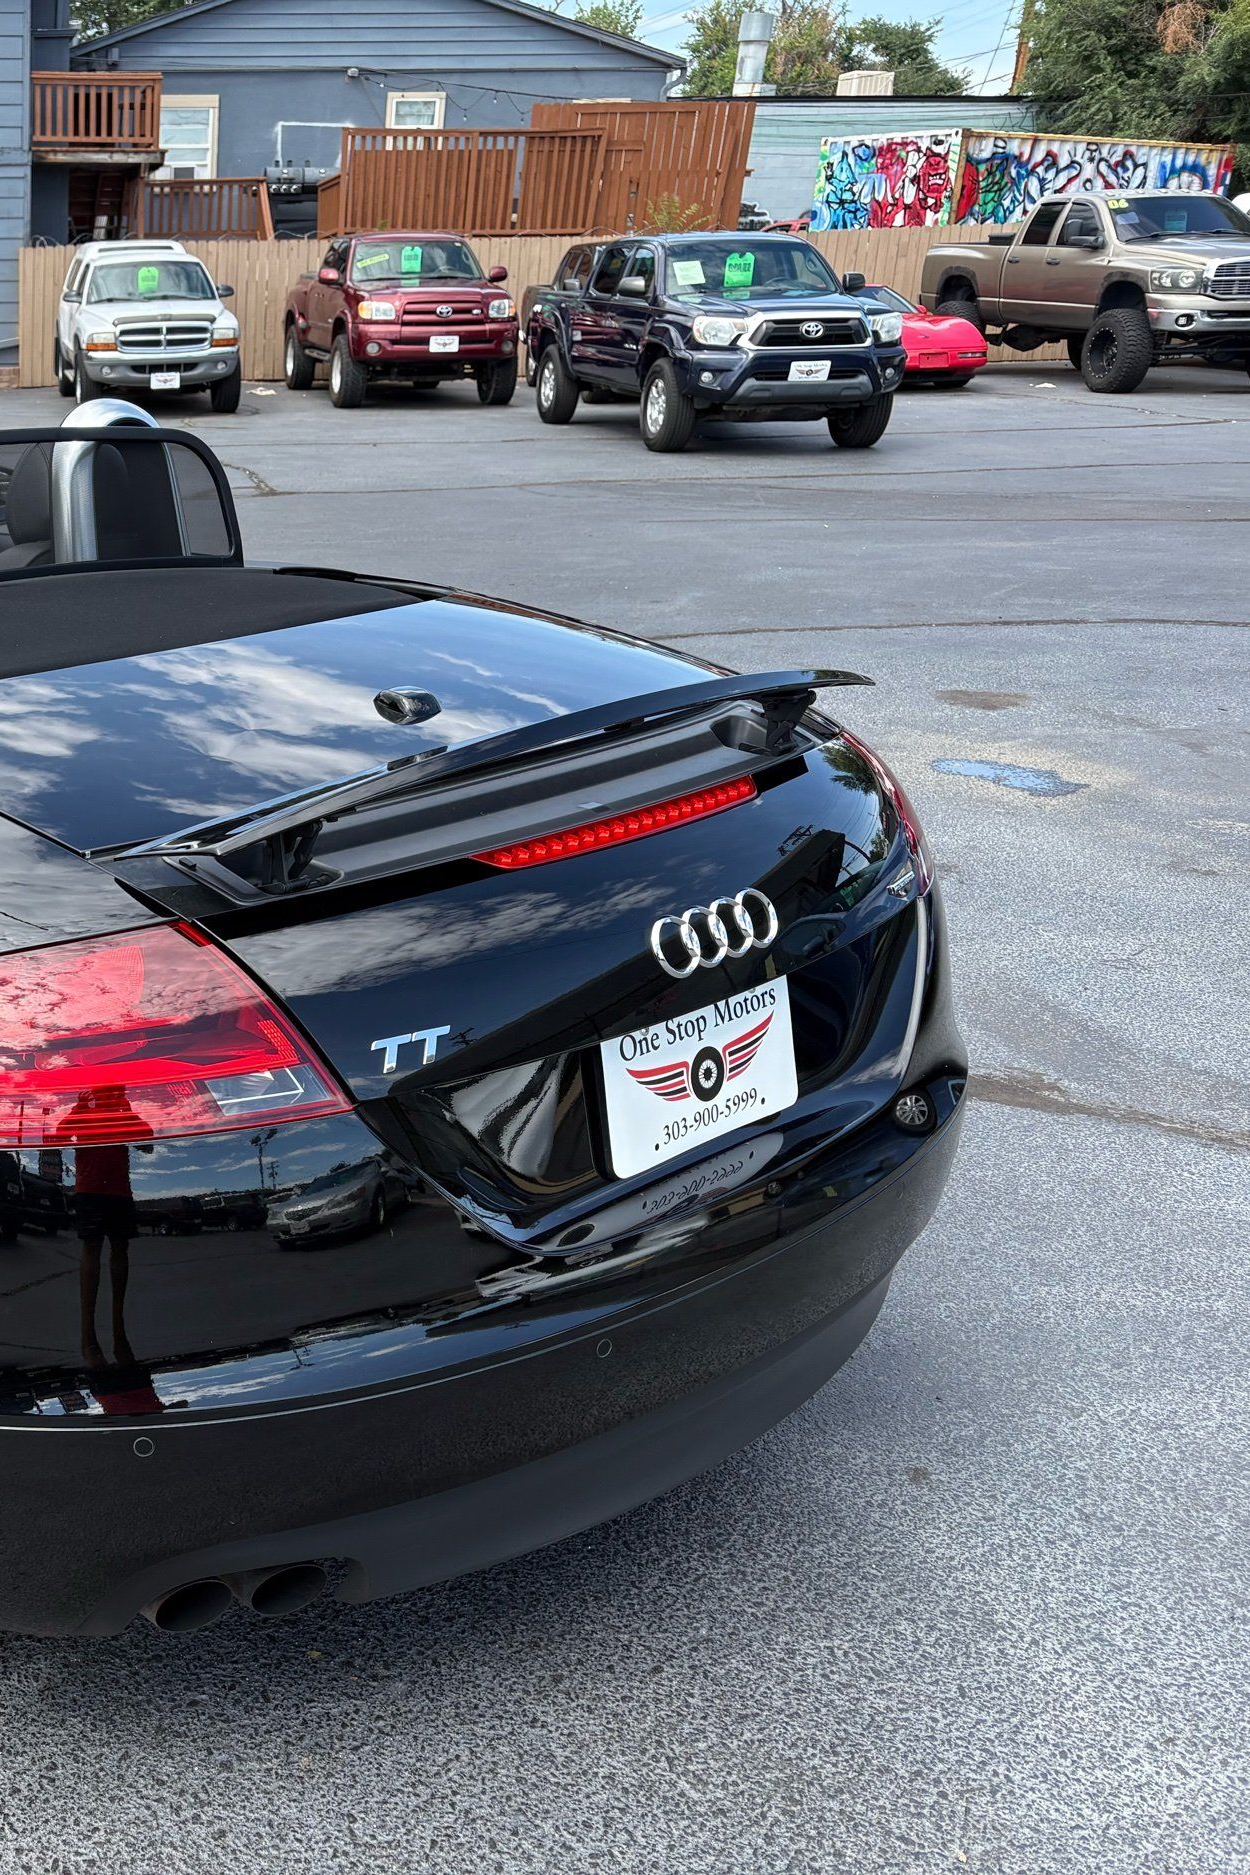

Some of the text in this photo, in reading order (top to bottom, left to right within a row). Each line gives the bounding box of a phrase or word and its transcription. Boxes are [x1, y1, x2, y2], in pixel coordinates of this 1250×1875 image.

[1108, 199, 1129, 209] 06
[371, 1025, 451, 1073] TT
[619, 987, 777, 1062] One Stop Motors
[662, 1088, 758, 1145] 303-900-5999
